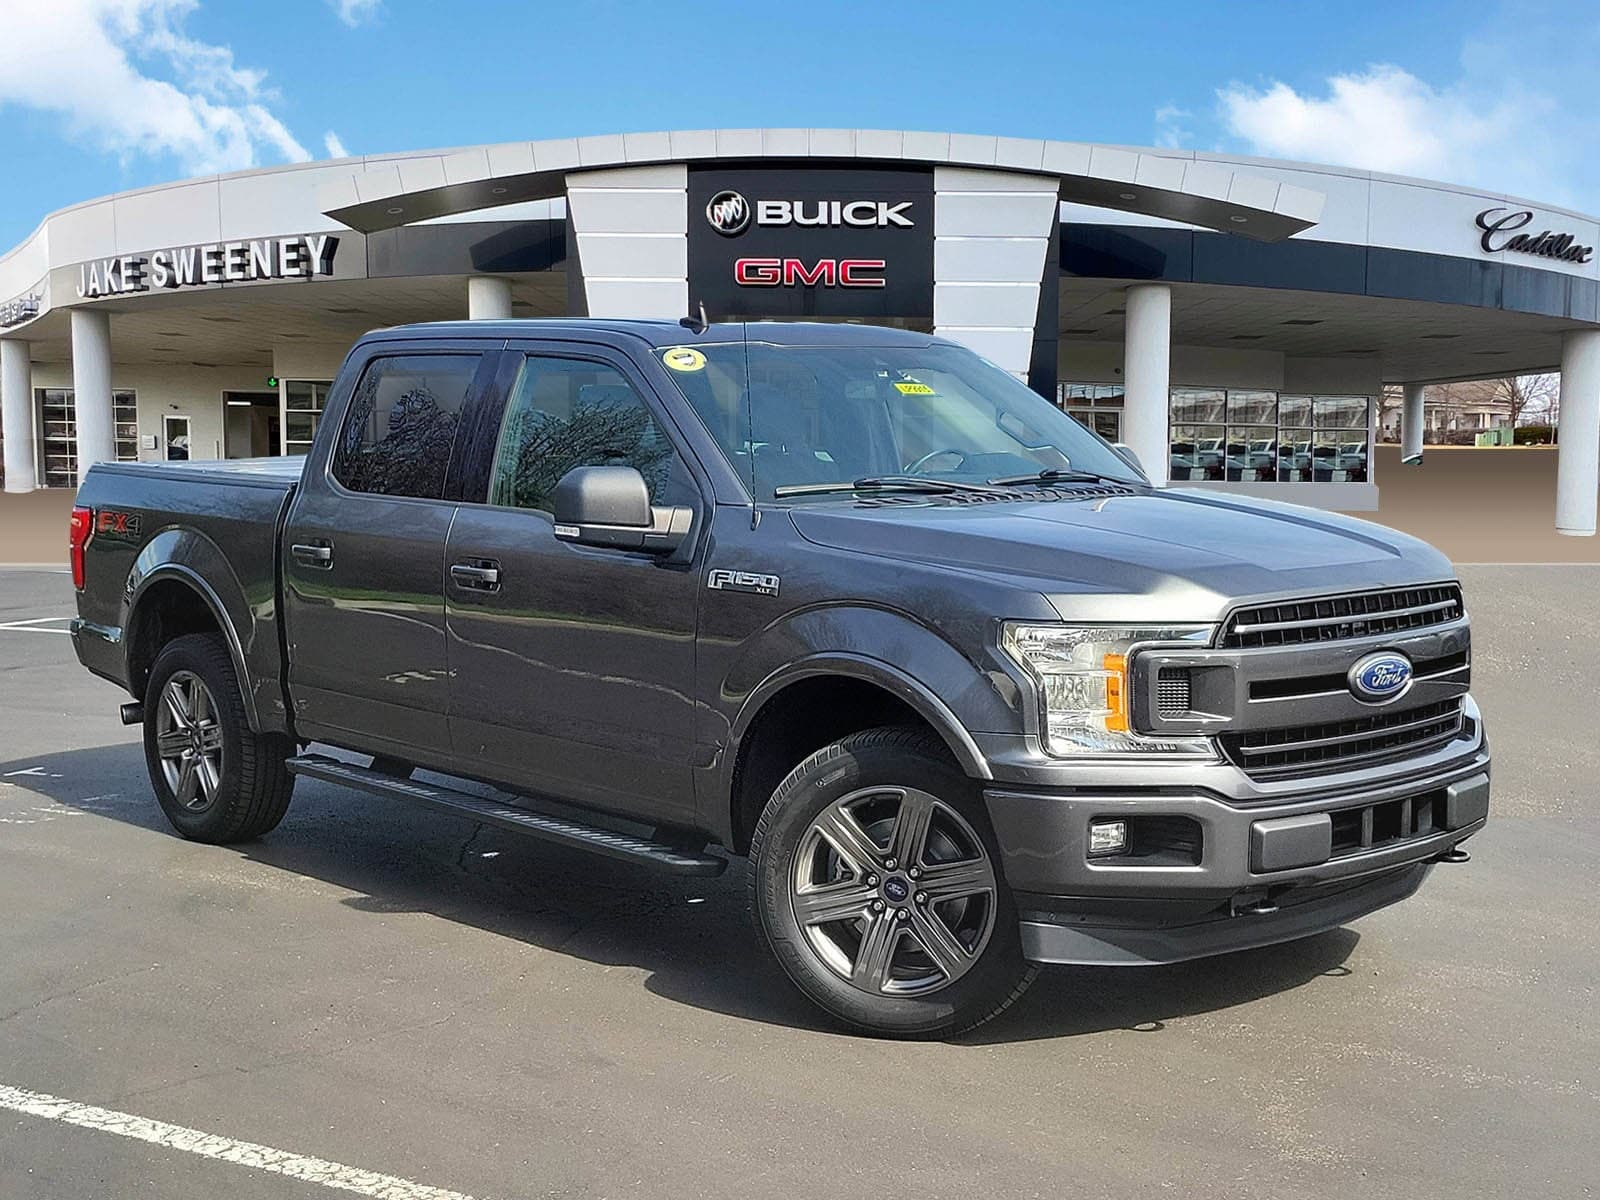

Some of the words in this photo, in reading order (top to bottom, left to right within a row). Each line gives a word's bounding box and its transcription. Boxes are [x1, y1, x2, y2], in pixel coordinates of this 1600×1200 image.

[757, 200, 915, 226] BUICK
[1475, 207, 1594, 264] Cadillac
[76, 255, 139, 298] JAKE
[151, 234, 337, 289] SWEENEY
[735, 258, 886, 287] GMC
[97, 511, 144, 537] FX4
[755, 586, 772, 594] XLT
[1371, 664, 1406, 687] Ford
